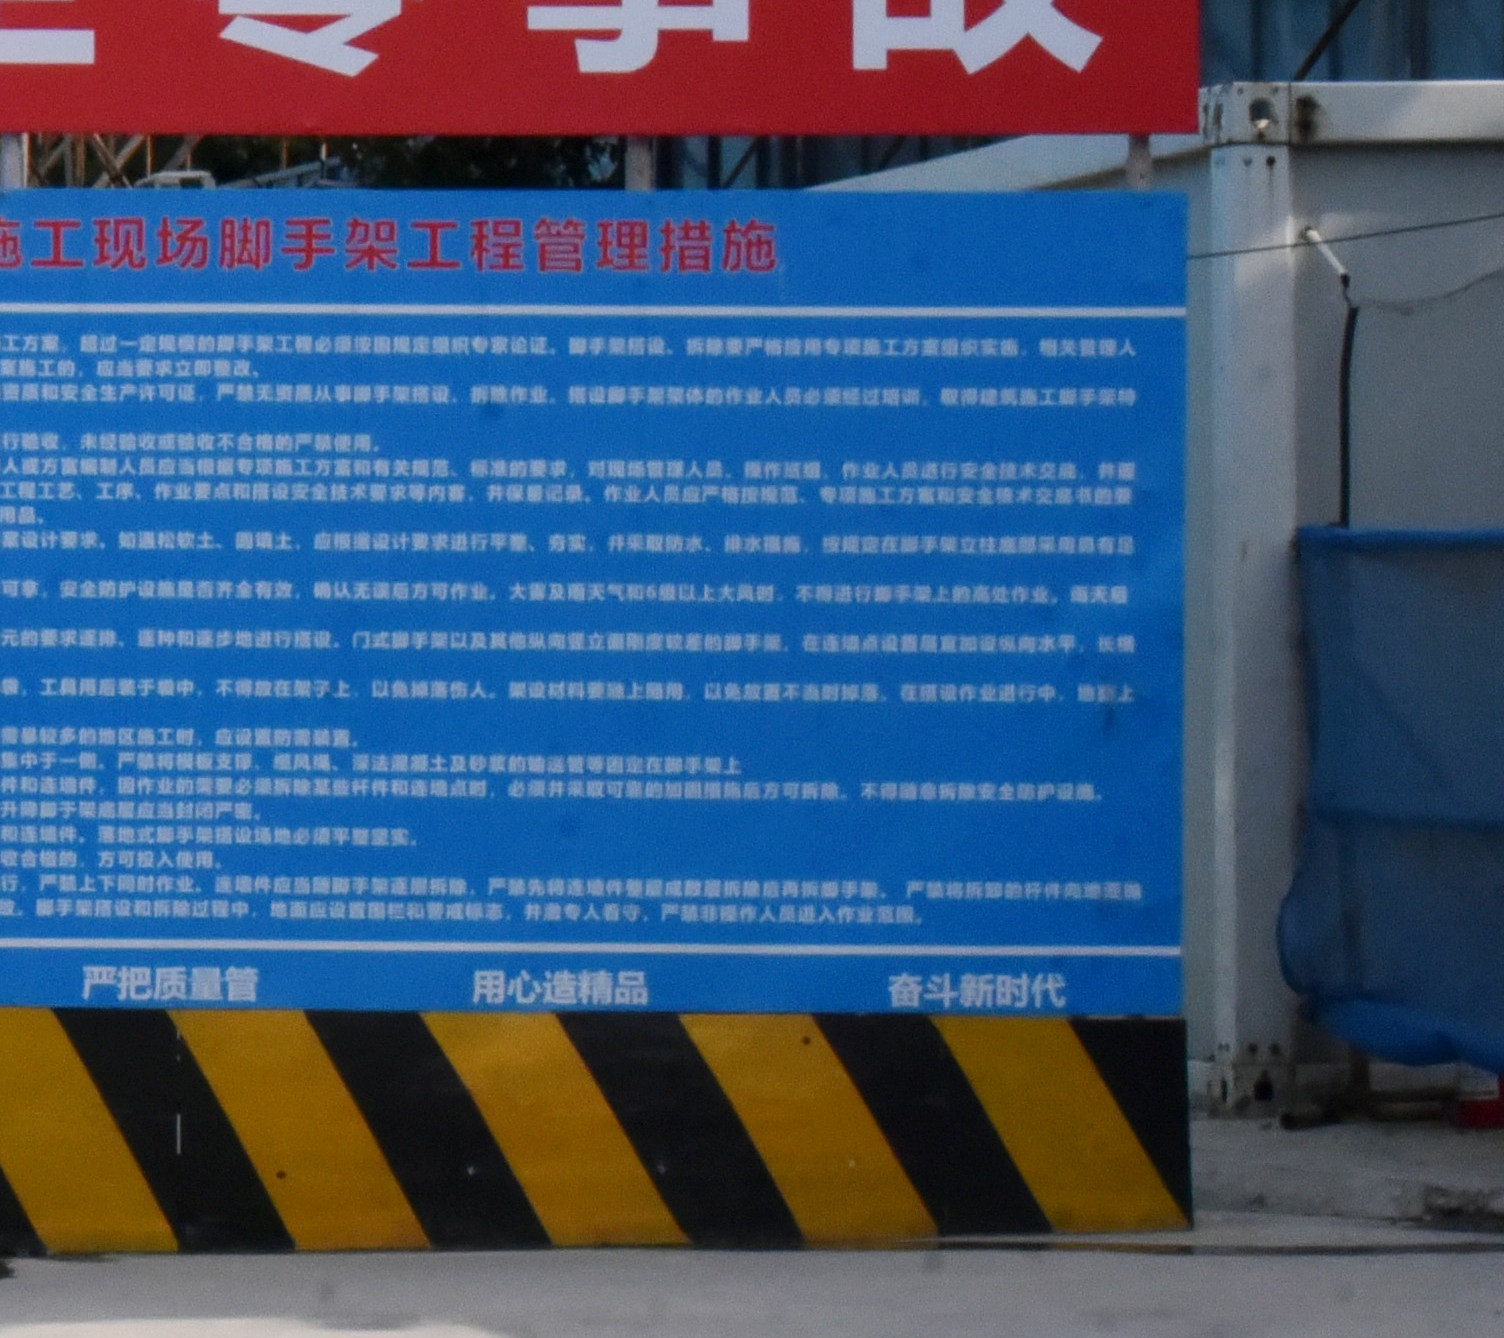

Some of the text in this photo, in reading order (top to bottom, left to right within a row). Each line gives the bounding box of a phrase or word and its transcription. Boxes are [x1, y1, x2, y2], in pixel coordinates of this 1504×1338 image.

[472, 970, 648, 1006] 用心造精品
[888, 973, 1066, 1009] 奋斗新时代
